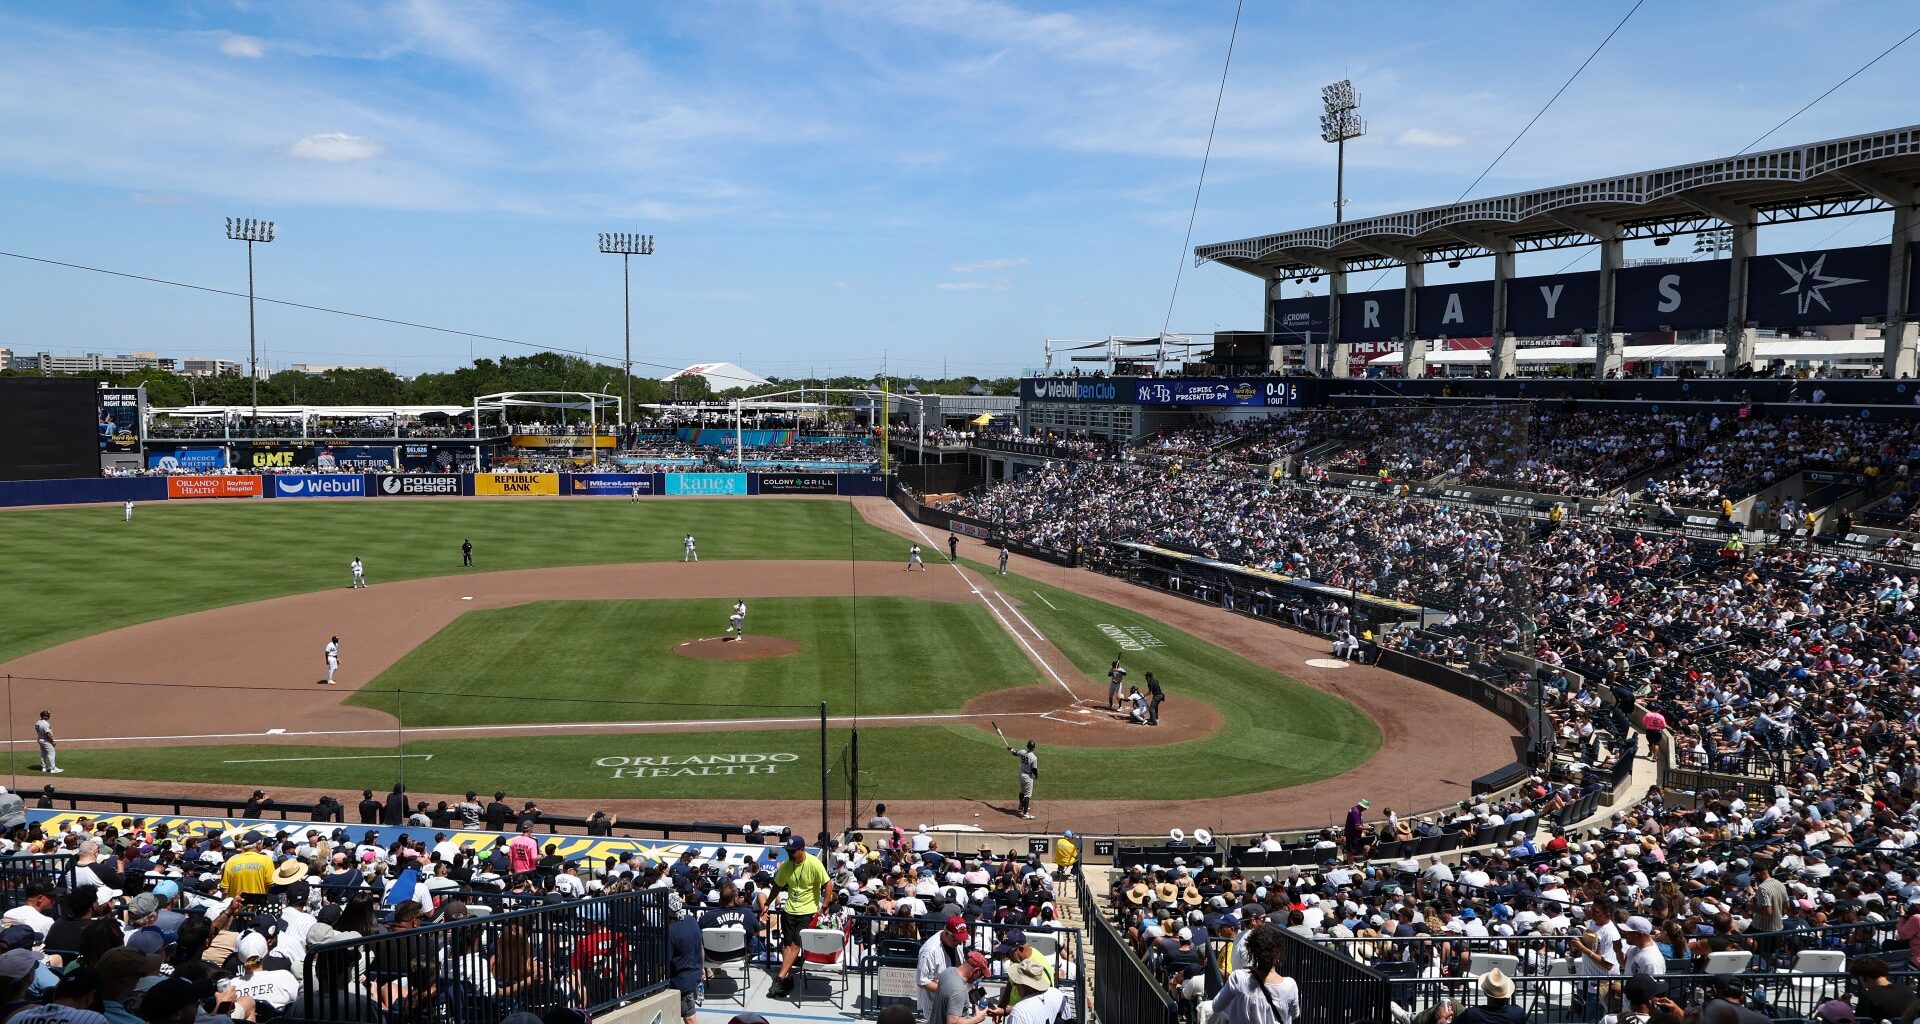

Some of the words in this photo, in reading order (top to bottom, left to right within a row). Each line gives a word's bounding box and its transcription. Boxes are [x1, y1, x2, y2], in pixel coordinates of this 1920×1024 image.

[1287, 312, 1310, 321] CROWN
[1349, 342, 1374, 352] THE
[1096, 383, 1116, 399] Club
[1266, 383, 1285, 396] 0-0
[1290, 388, 1297, 400] 5
[1175, 393, 1215, 401] PRESENTED
[1217, 392, 1227, 400] BY
[253, 451, 294, 467] GMF
[340, 459, 352, 467] HIT
[353, 459, 367, 467] THE
[368, 459, 389, 467] BUDS
[494, 475, 539, 483] REPUBLIC
[307, 479, 360, 493] Webull
[503, 484, 530, 492] BANK
[595, 753, 800, 767] ORLANDO
[610, 764, 780, 779] HEALTH
[1034, 844, 1044, 852] 12
[1100, 846, 1108, 854] 11
[716, 912, 745, 925] RIVERA
